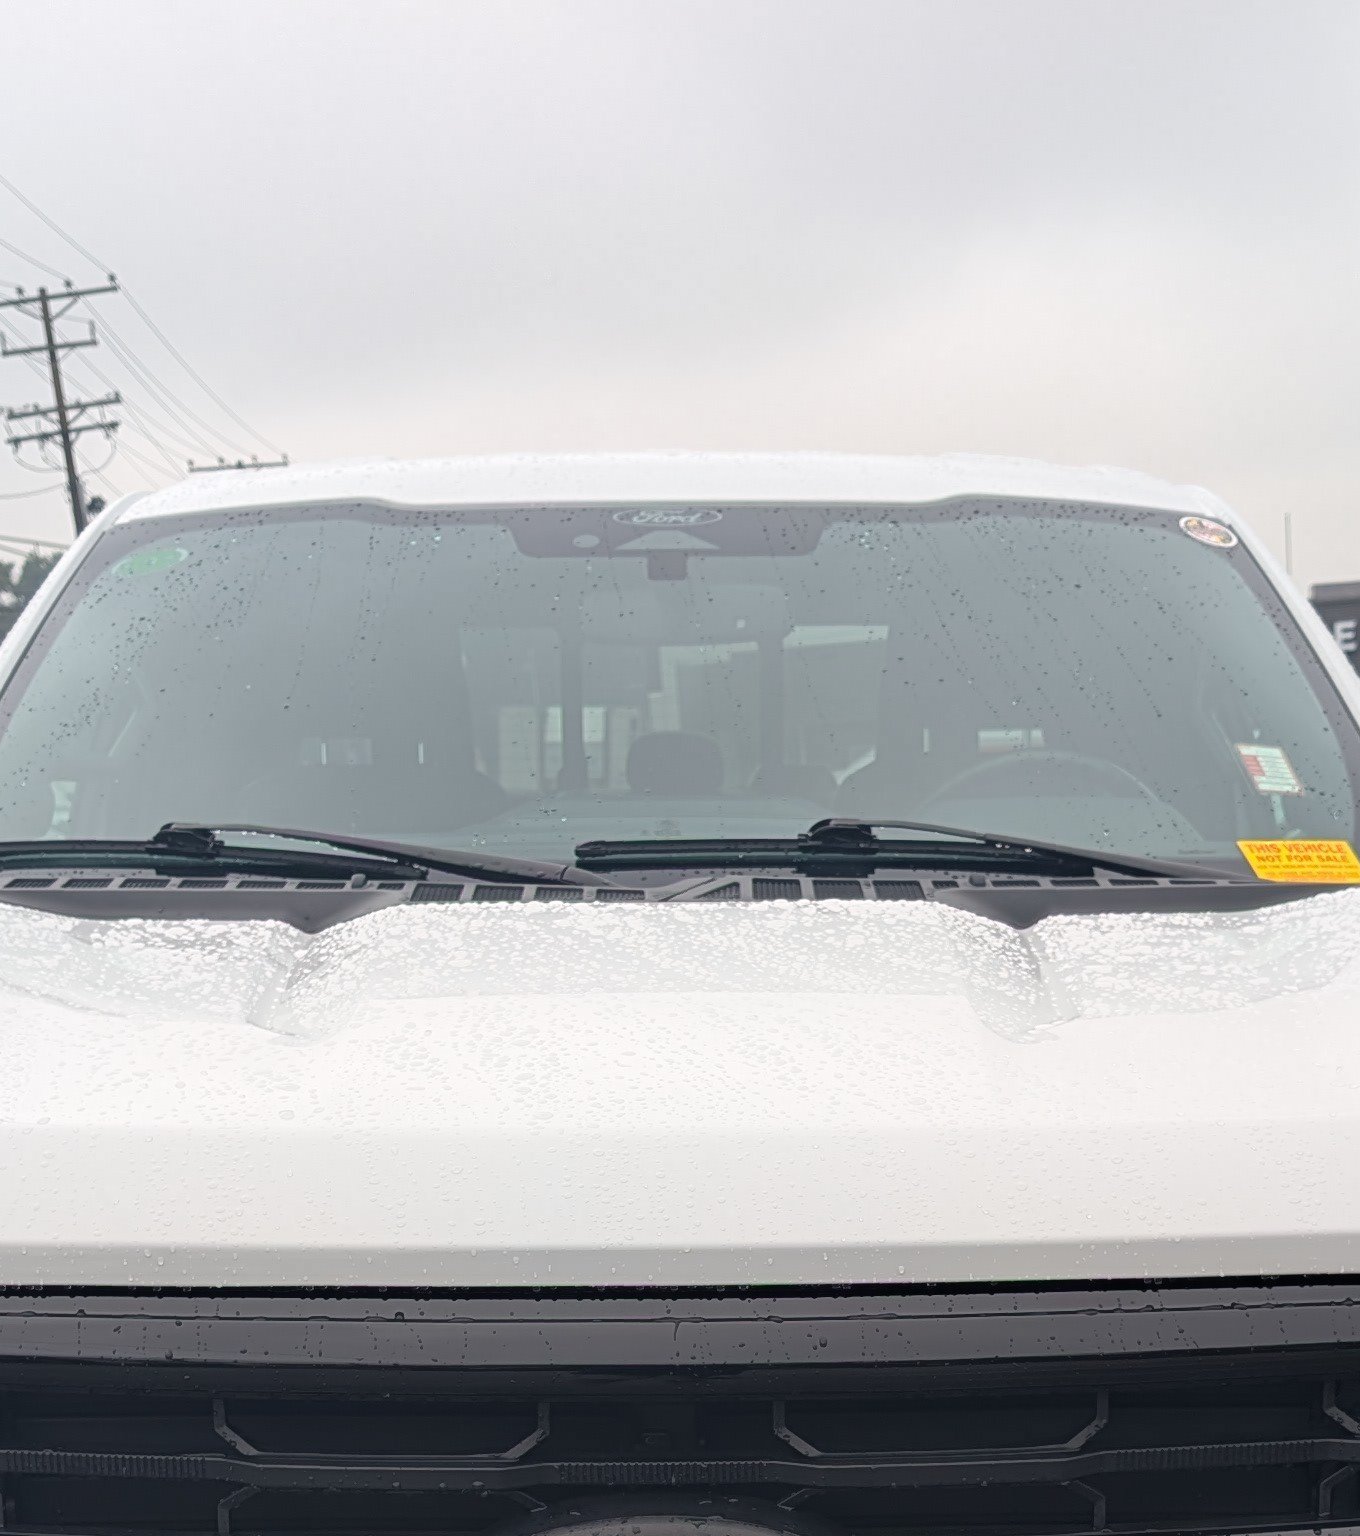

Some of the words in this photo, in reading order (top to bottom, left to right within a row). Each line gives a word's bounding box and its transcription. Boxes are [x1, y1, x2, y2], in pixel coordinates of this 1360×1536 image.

[1246, 843, 1281, 854] THIS
[1283, 843, 1348, 854] VEHICLE
[1256, 854, 1282, 863] NOT
[1286, 854, 1313, 863] FOR
[1316, 854, 1350, 863] SALE
